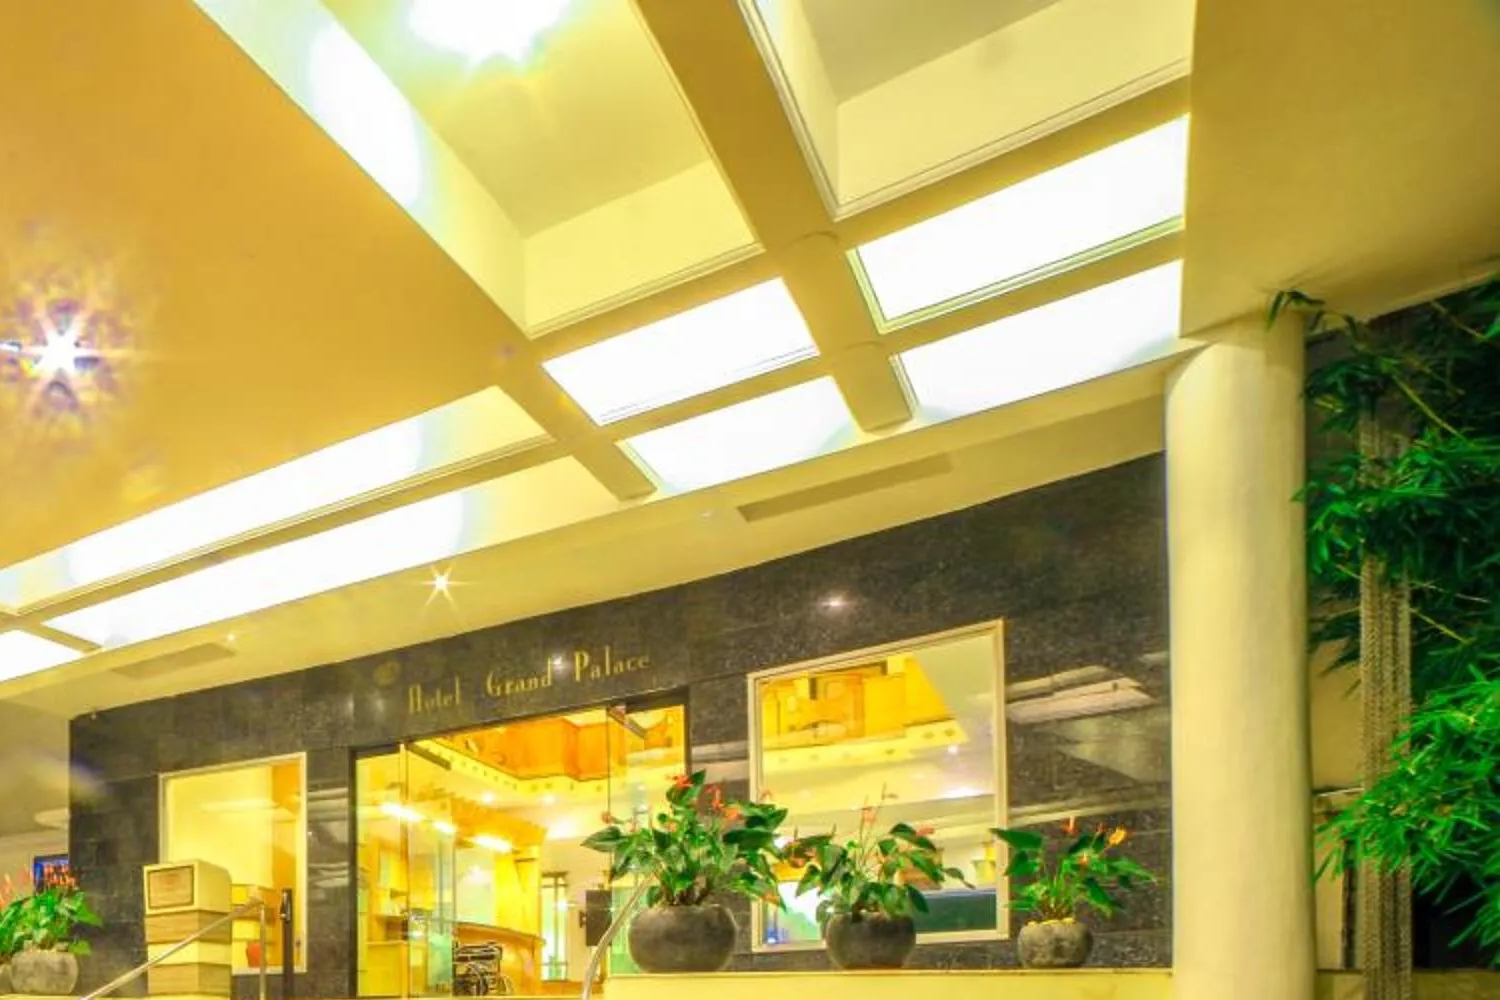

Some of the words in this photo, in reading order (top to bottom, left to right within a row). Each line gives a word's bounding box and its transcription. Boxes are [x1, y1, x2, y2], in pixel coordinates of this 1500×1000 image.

[408, 675, 461, 714] Hotel
[485, 656, 553, 698] Grand
[573, 644, 651, 682] Palace
